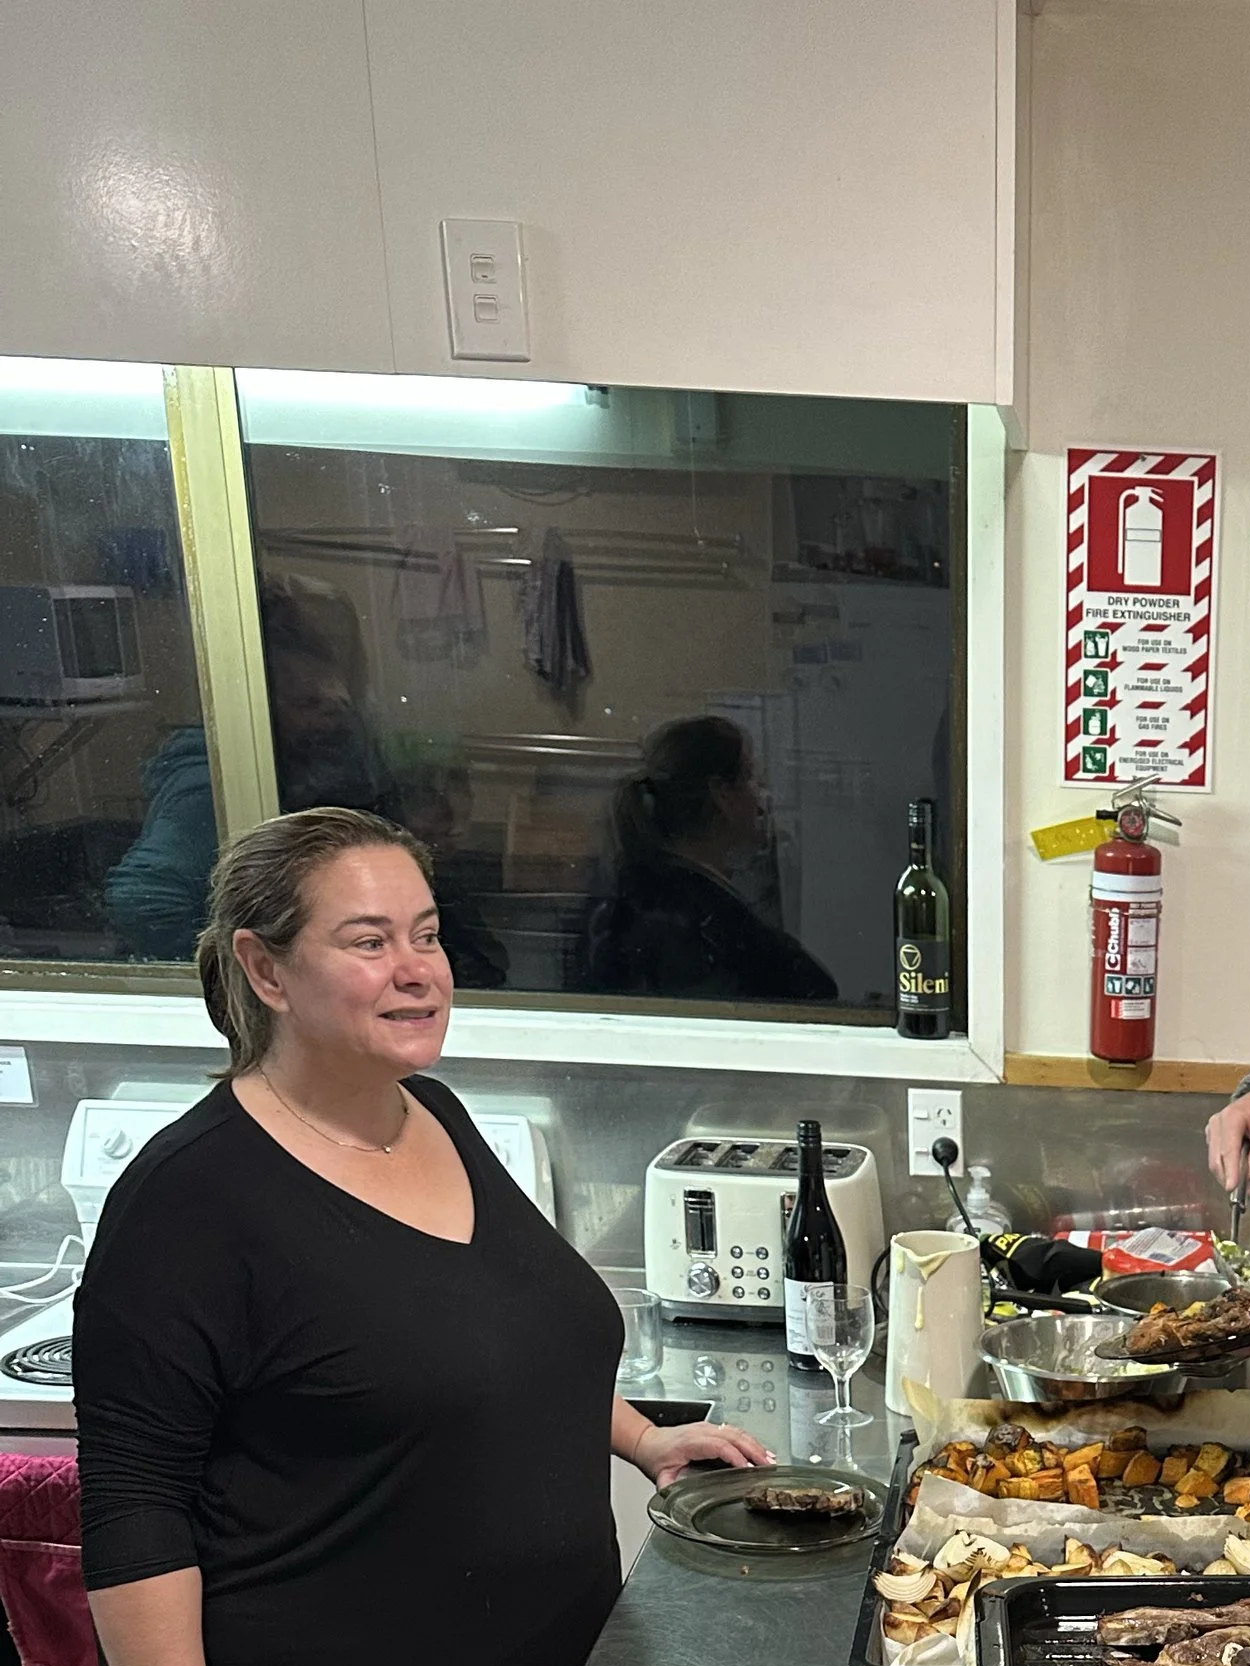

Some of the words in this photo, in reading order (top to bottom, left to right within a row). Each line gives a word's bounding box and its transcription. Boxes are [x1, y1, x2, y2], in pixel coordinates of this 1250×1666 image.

[1107, 596, 1130, 606] DRY
[1133, 597, 1180, 608] POWDER
[1086, 608, 1110, 618] FIRE
[1112, 610, 1191, 622] EXTINGUISHER
[1124, 684, 1158, 692] FLAMMABLE
[1107, 907, 1120, 954] Chubb
[899, 971, 949, 994] Sileni
